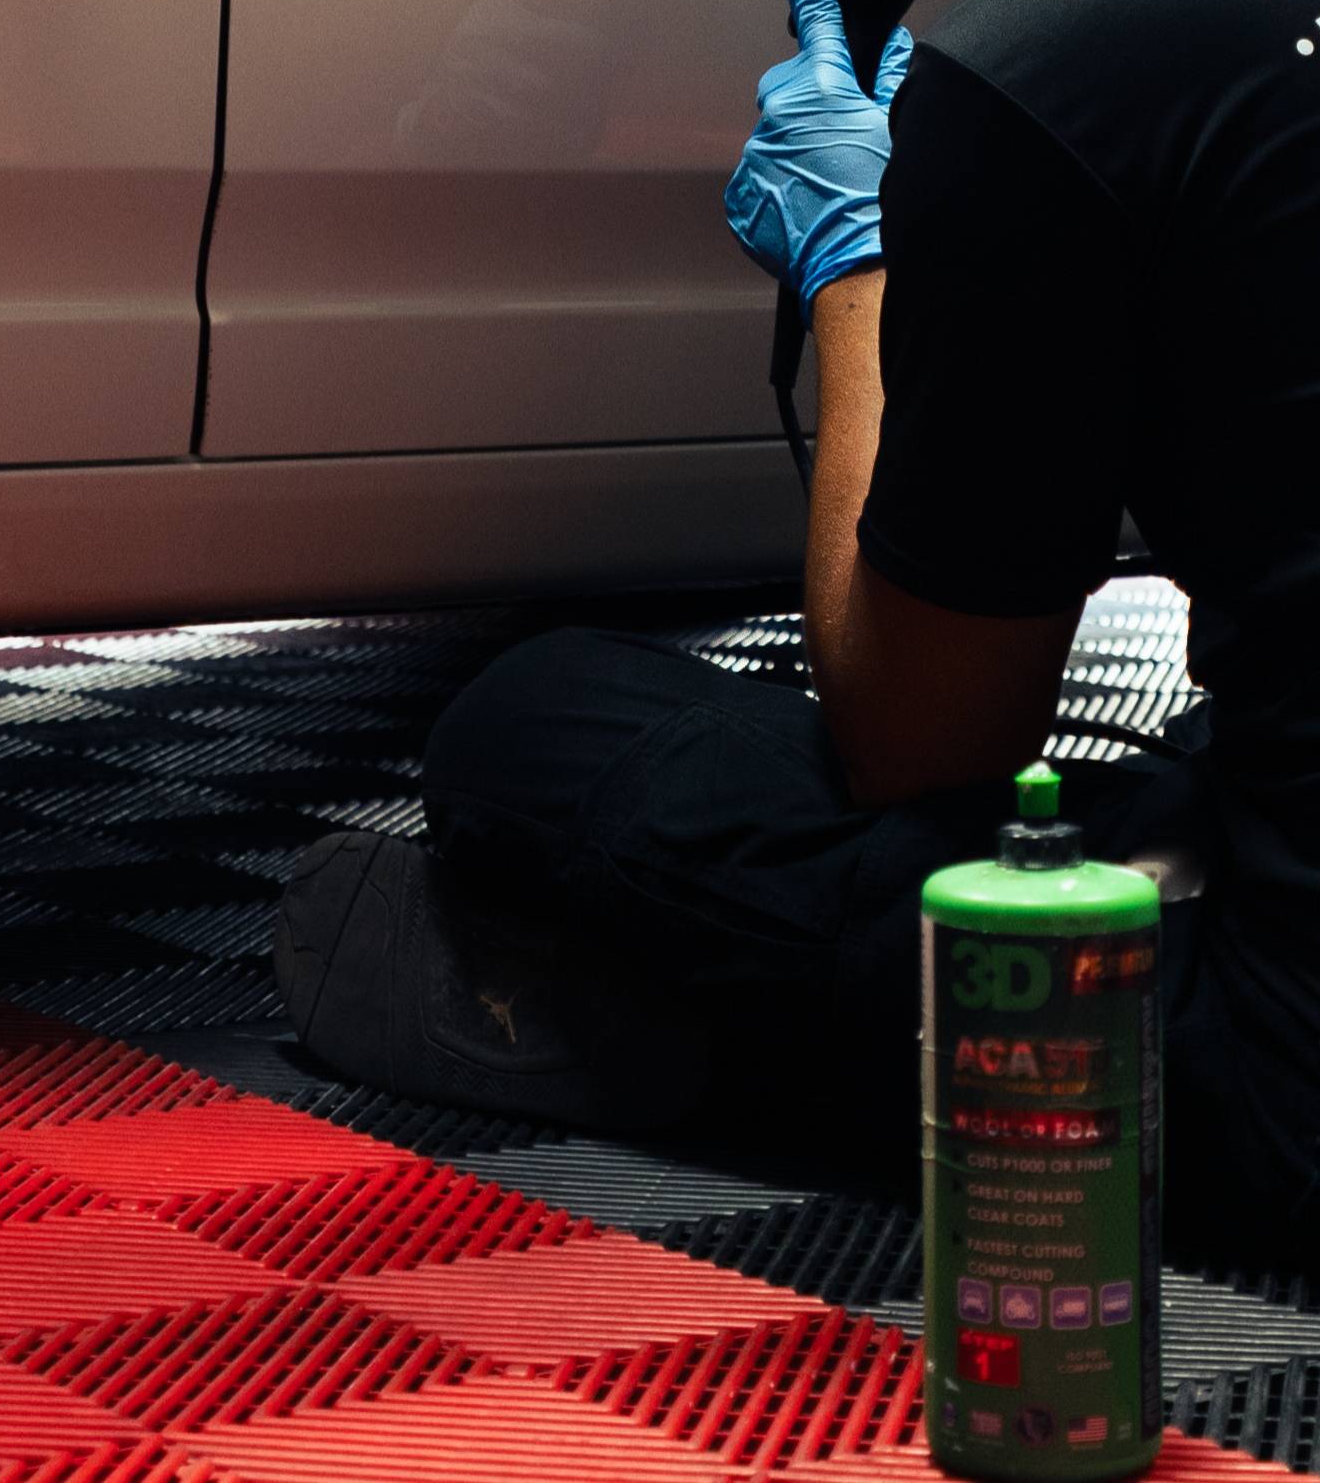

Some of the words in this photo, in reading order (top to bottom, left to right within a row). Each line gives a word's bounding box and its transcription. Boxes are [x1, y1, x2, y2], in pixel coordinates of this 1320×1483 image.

[951, 938, 1053, 1012] 3D
[1013, 1189, 1038, 1203] ON
[1041, 1190, 1085, 1204] HARD
[1012, 1212, 1065, 1228] COATS
[1021, 1243, 1085, 1259] CUTTING
[967, 1260, 1055, 1283] COMPOUND
